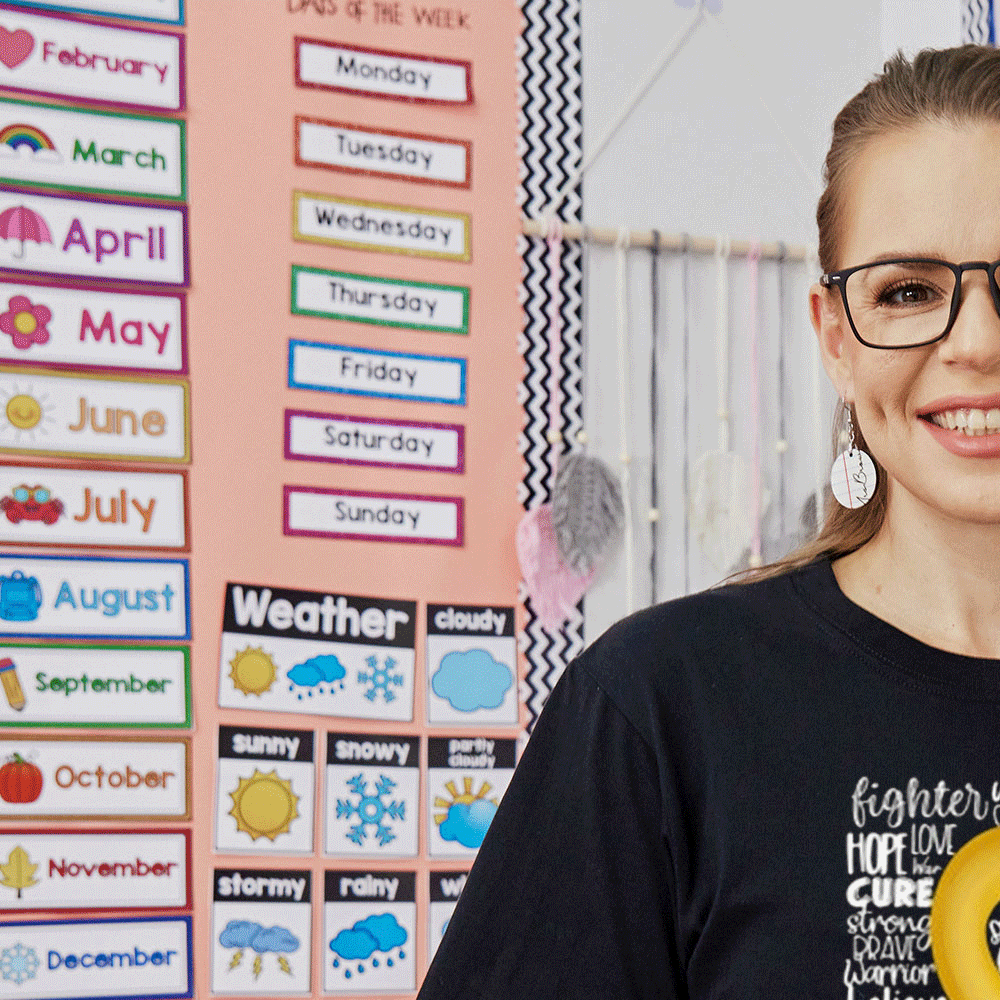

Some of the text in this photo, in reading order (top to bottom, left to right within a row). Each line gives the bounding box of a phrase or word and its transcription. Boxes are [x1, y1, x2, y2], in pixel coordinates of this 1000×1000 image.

[412, 5, 470, 29] WEEK
[43, 41, 168, 83] February
[336, 56, 432, 91] Monday
[72, 138, 167, 171] March
[337, 135, 434, 170] Tuesday
[62, 219, 166, 263] April
[315, 208, 452, 246] Wednesday
[329, 281, 438, 317] Thursday
[80, 309, 170, 355] May
[341, 357, 417, 387] Friday
[69, 398, 166, 437] June
[324, 426, 435, 457] Saturday
[74, 489, 156, 533] July
[335, 502, 420, 530] Sunday
[54, 581, 174, 616] August
[232, 587, 409, 641] Weather
[434, 608, 508, 637] cloudy
[36, 674, 171, 697] September
[232, 733, 299, 758] sunny
[335, 738, 411, 765] snowy
[448, 752, 496, 769] cloudy
[449, 738, 495, 755] partly
[55, 765, 175, 791] October
[852, 776, 989, 828] fighter
[847, 824, 957, 875] HOPE LOVE
[49, 857, 178, 880] November
[219, 874, 305, 901] stormy
[340, 876, 399, 900] rainy
[846, 876, 934, 907] CURE
[847, 907, 932, 951] strong
[48, 947, 177, 971] December
[853, 934, 917, 961] BRAVE
